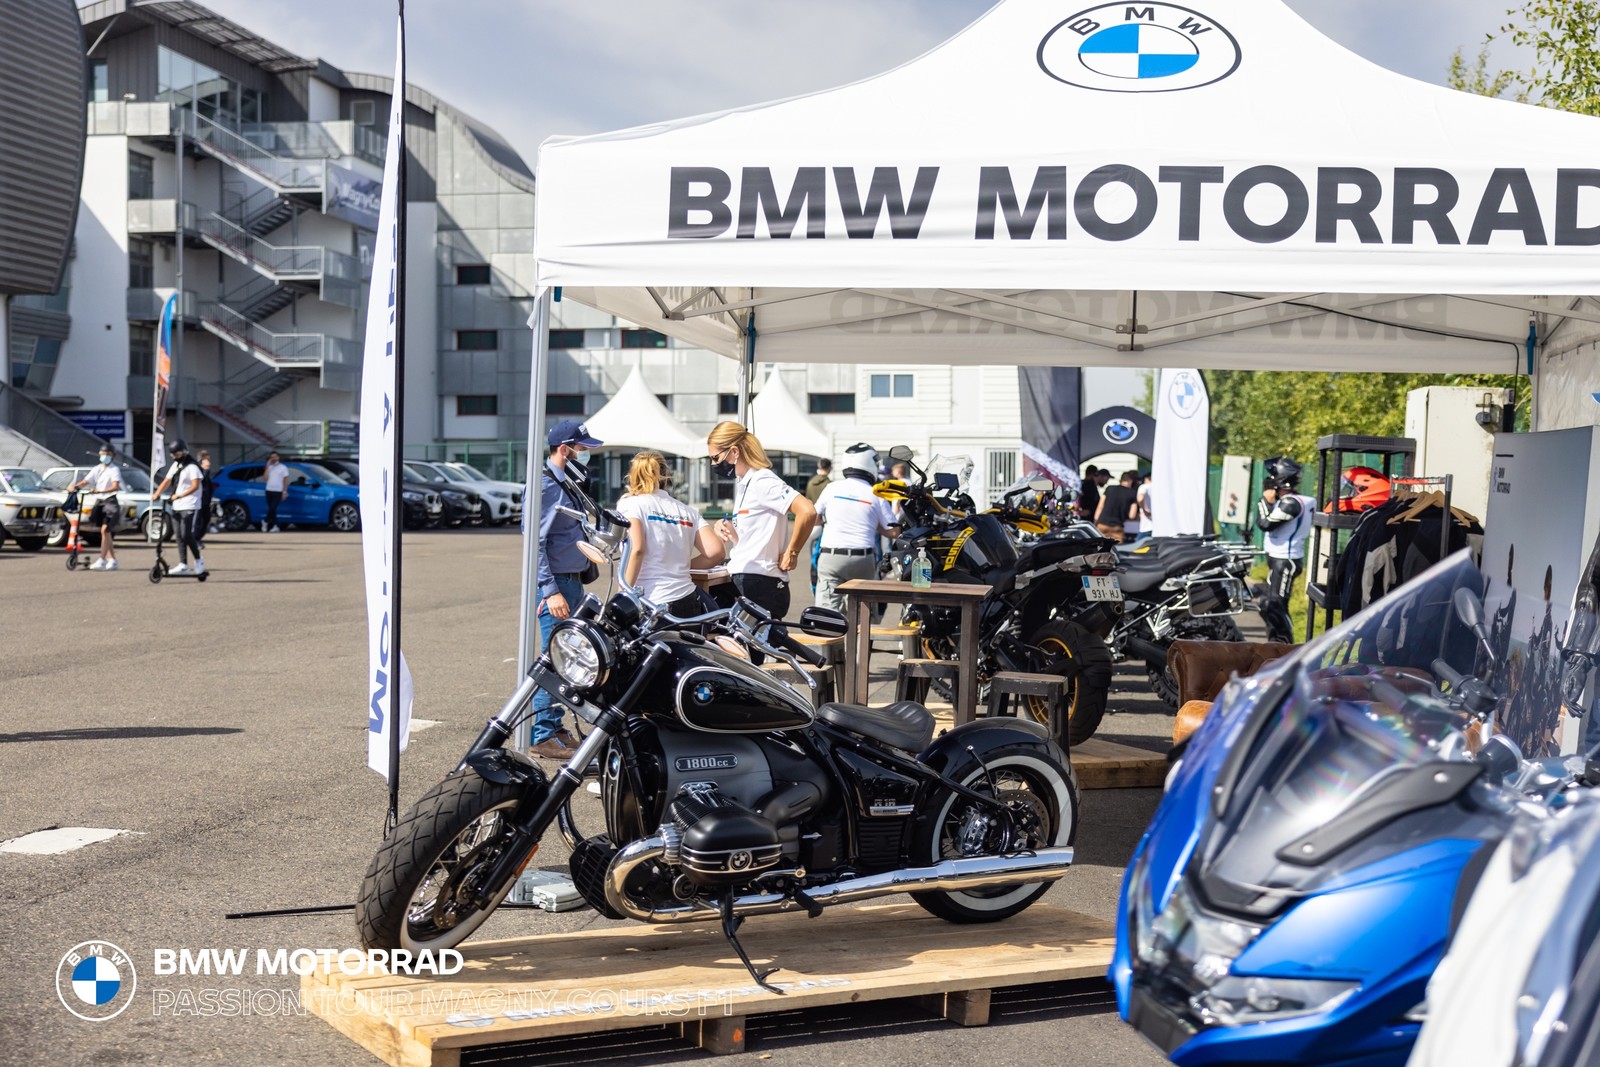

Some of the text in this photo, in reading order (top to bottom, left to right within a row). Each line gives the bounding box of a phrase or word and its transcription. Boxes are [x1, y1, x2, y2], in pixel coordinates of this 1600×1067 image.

[1067, 6, 1213, 37] BMW
[667, 163, 1600, 246] BMW MOTORRAD
[686, 757, 729, 769] 1800cc
